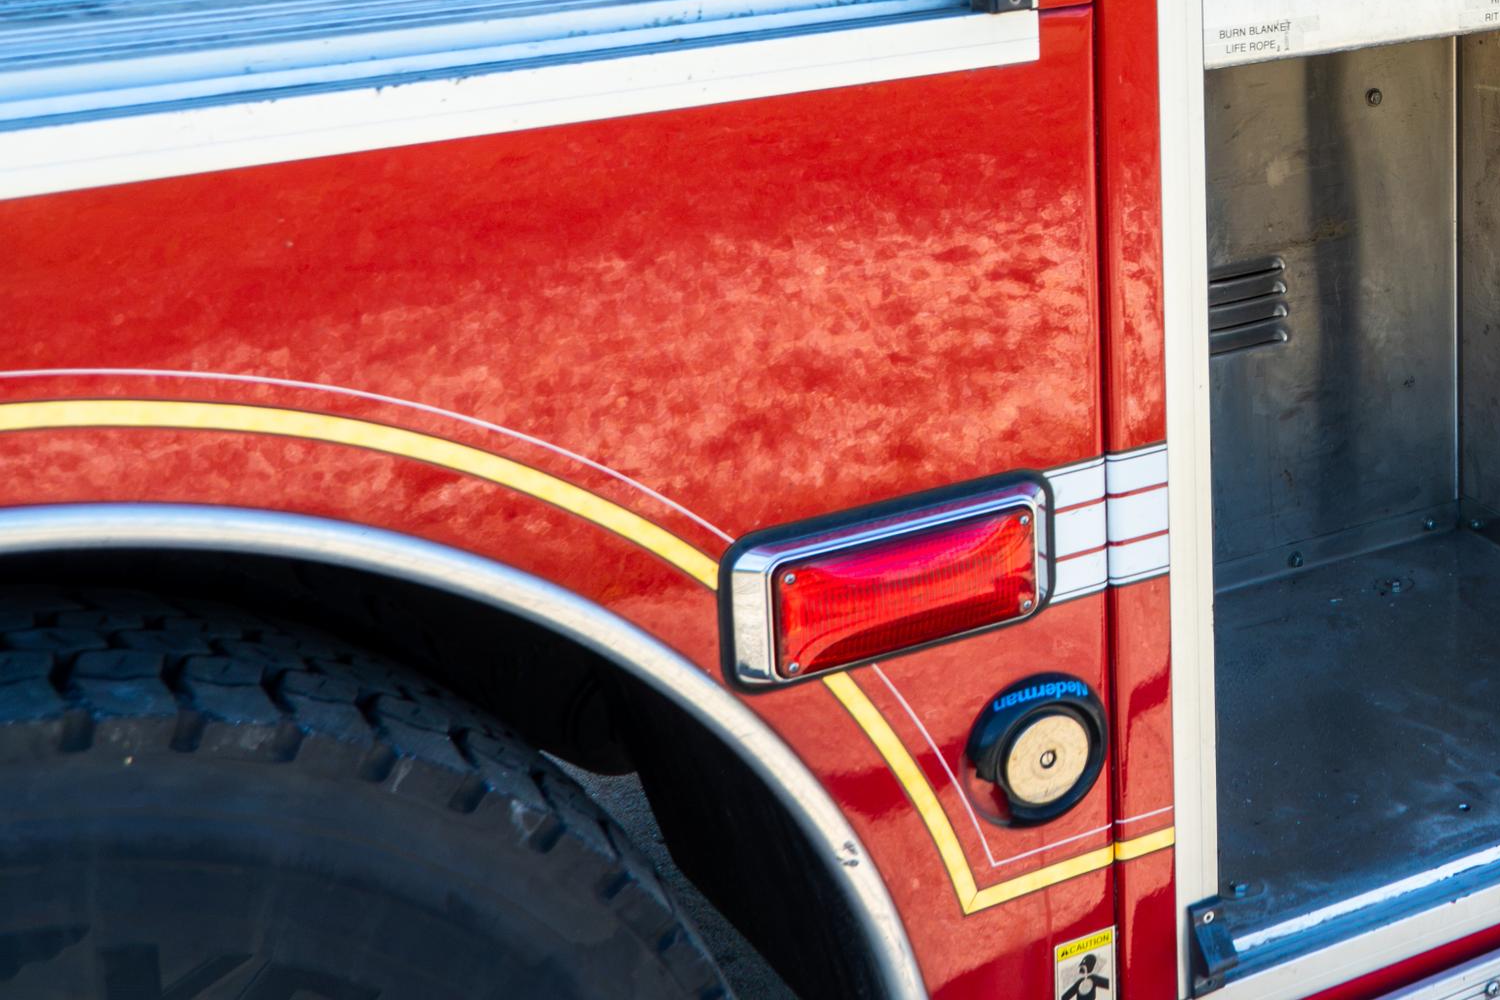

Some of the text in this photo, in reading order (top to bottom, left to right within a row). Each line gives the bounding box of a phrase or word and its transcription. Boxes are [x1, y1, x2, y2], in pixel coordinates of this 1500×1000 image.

[1485, 10, 1499, 22] RIT
[1219, 21, 1292, 40] BURN BLANKET
[1225, 40, 1276, 54] LIFE ROPE
[993, 680, 1089, 712] Nederman
[1069, 932, 1110, 954] CAUTION
